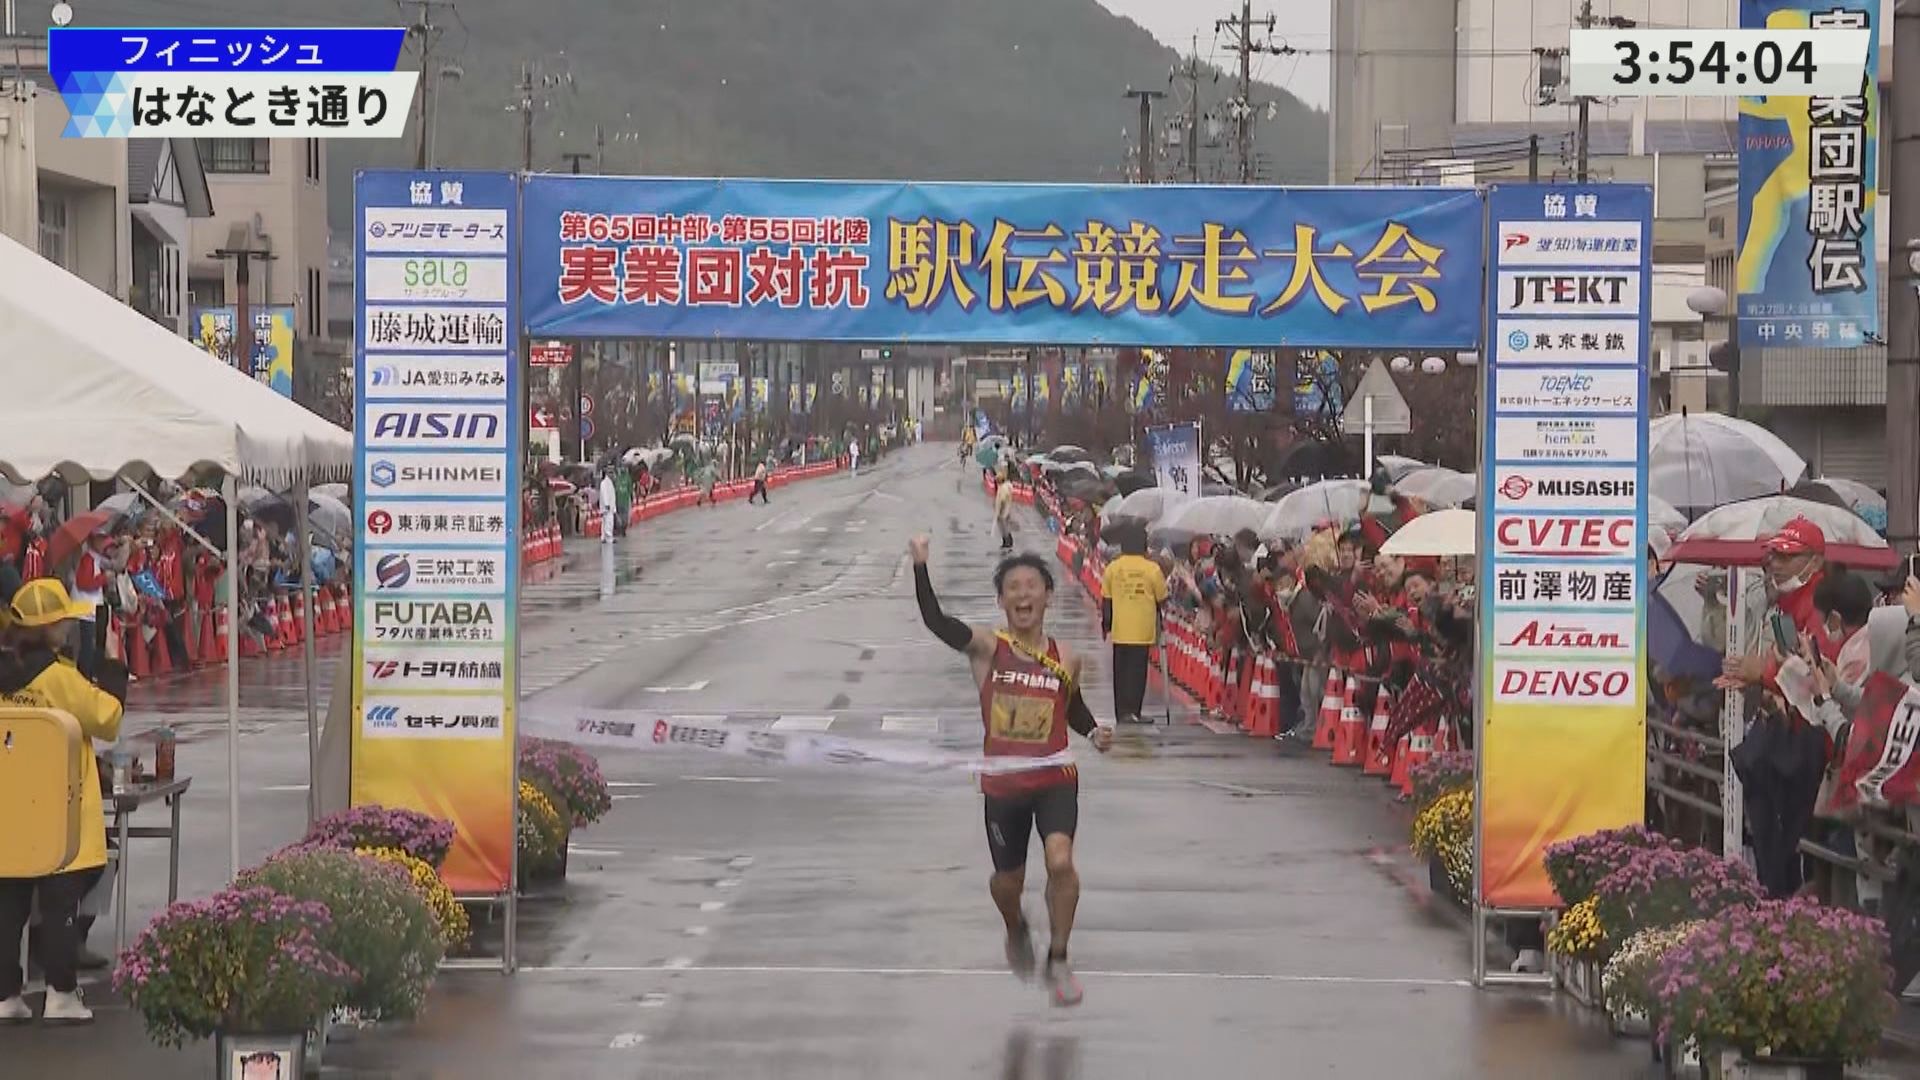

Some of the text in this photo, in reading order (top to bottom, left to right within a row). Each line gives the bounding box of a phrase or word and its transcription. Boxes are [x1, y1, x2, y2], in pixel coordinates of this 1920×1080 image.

[387, 222, 504, 239] アツミモータース
[561, 211, 869, 245] 第65回中部・第55回北陸
[559, 247, 869, 307] 実業団対抗
[885, 216, 1447, 315] 駅伝競走大会
[1510, 276, 1628, 309] JTEKT
[371, 311, 503, 344] 藤城運輸
[402, 370, 505, 386] JA愛知みなみ
[1539, 373, 1594, 395] TOENEC
[374, 412, 498, 438] AISIN
[401, 466, 501, 481] SHINMEI
[398, 515, 504, 532] 東海東京証券
[1497, 517, 1634, 547] CVTEC
[416, 558, 495, 576] 三栄工業
[1498, 569, 1632, 601] 前澤物産
[375, 601, 493, 625] FUTABA
[375, 627, 493, 640] フタバ産業株式会社
[403, 660, 501, 678] トヨタ紡織
[1500, 669, 1629, 697] DENSO
[404, 714, 499, 729] セキノ興産
